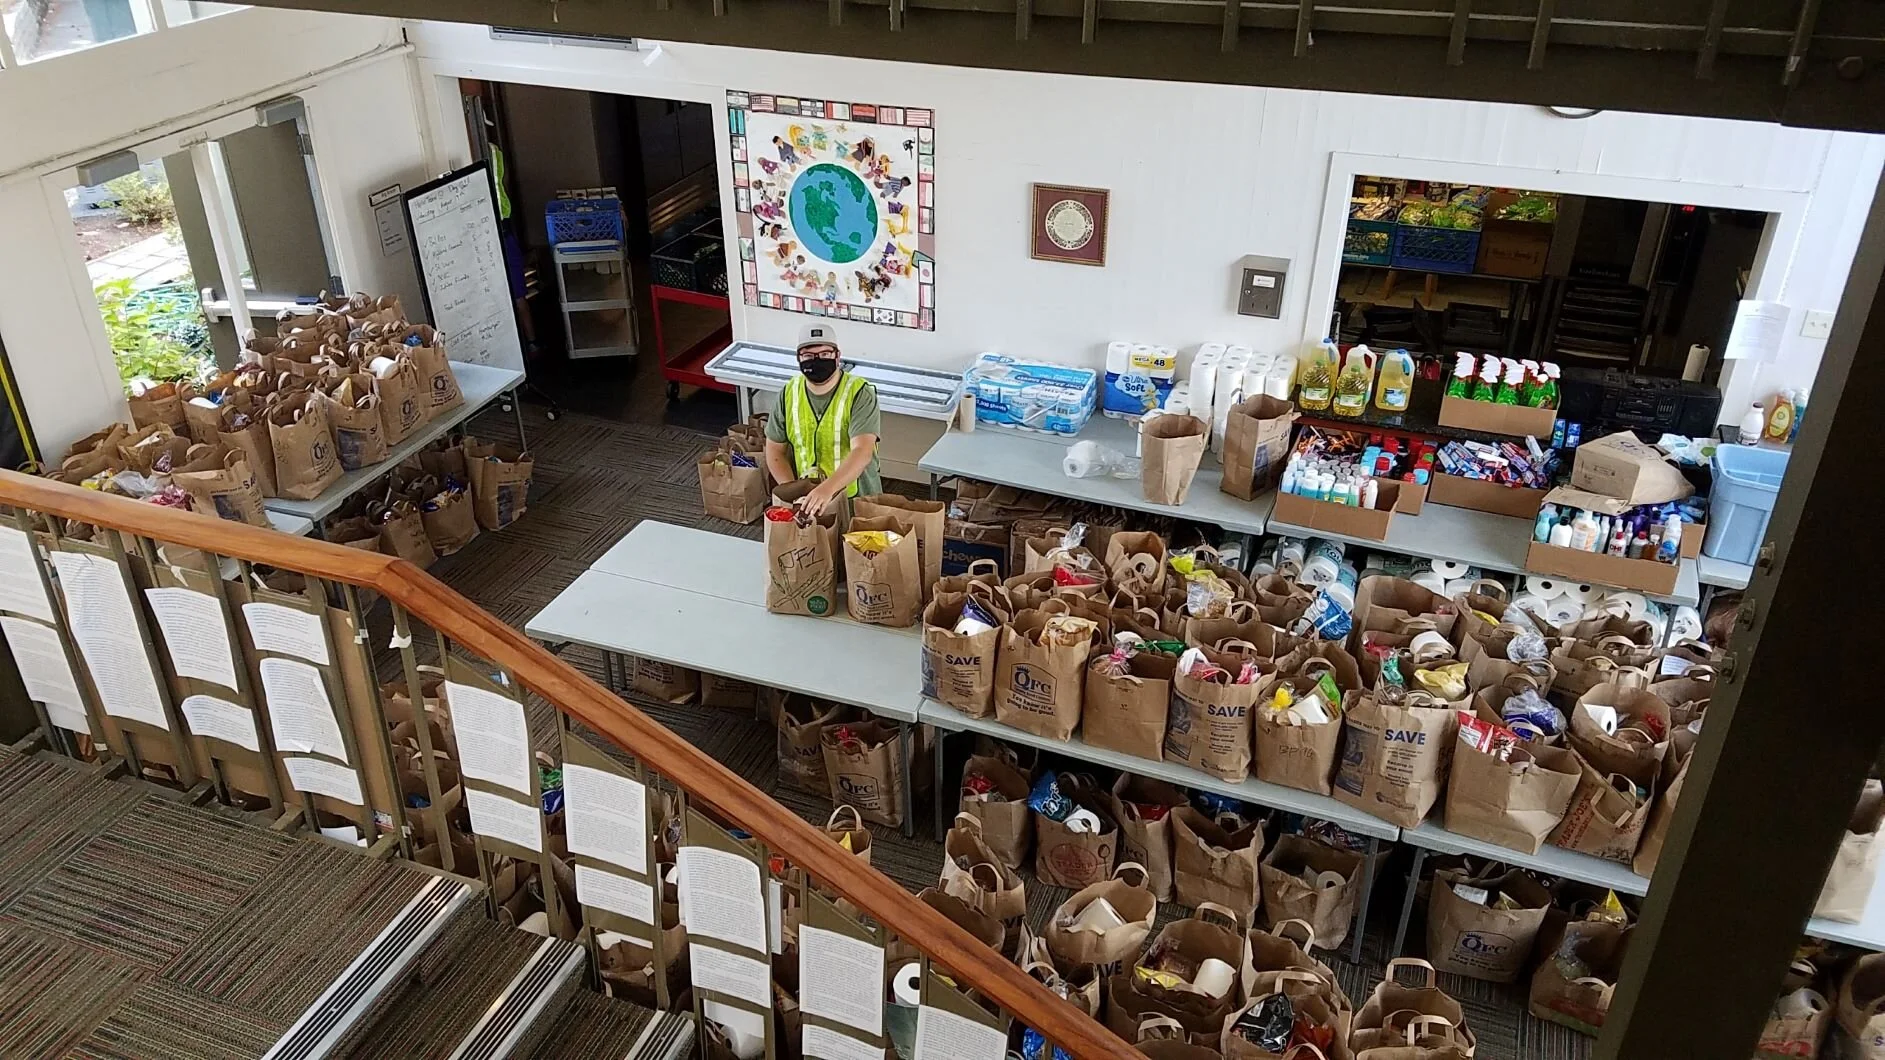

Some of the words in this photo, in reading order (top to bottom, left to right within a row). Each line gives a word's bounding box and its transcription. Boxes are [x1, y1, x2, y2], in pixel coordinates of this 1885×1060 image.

[1125, 383, 1146, 392] Soft
[856, 588, 887, 604] QFC
[946, 654, 981, 666] SAVE
[1014, 671, 1052, 694] QFC
[1208, 704, 1246, 717] SAVE
[1384, 728, 1426, 745] SAVE
[840, 779, 873, 794] QFC
[1462, 938, 1507, 954] QFC
[1098, 960, 1122, 978] AVE
